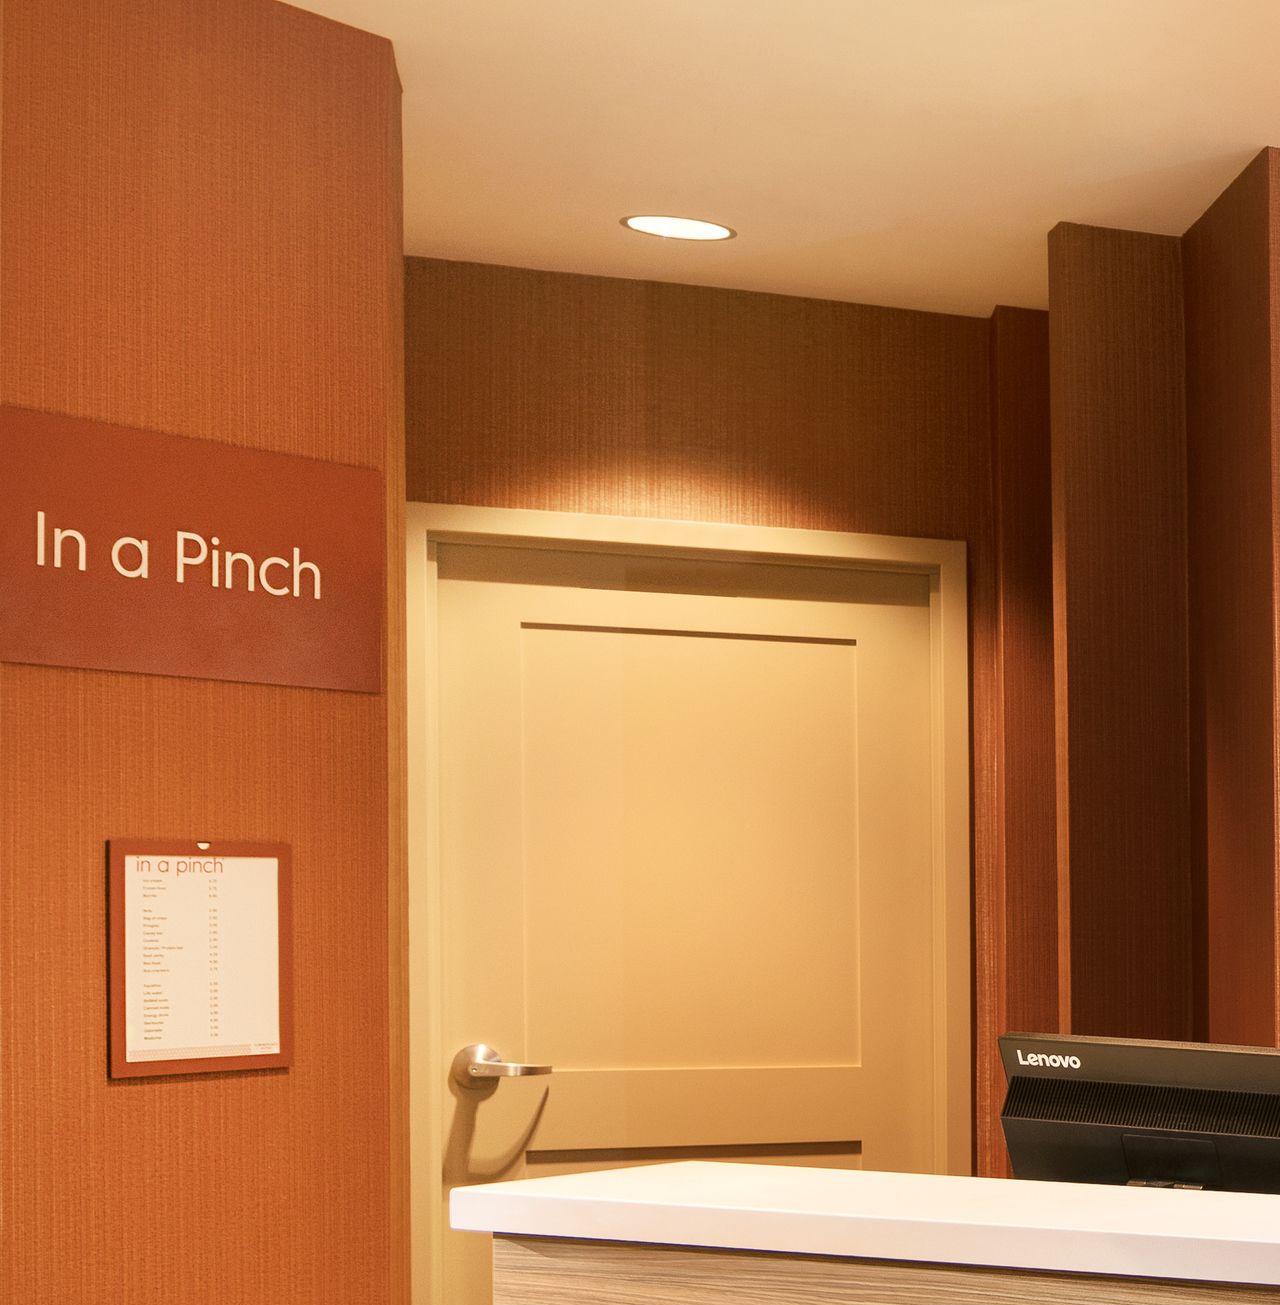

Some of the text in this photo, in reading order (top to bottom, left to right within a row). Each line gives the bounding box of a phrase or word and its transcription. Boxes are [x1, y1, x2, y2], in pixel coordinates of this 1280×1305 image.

[36, 510, 322, 600] In a Pinch
[136, 855, 224, 877] in a pinch
[1016, 1049, 1081, 1069] Lenovo
